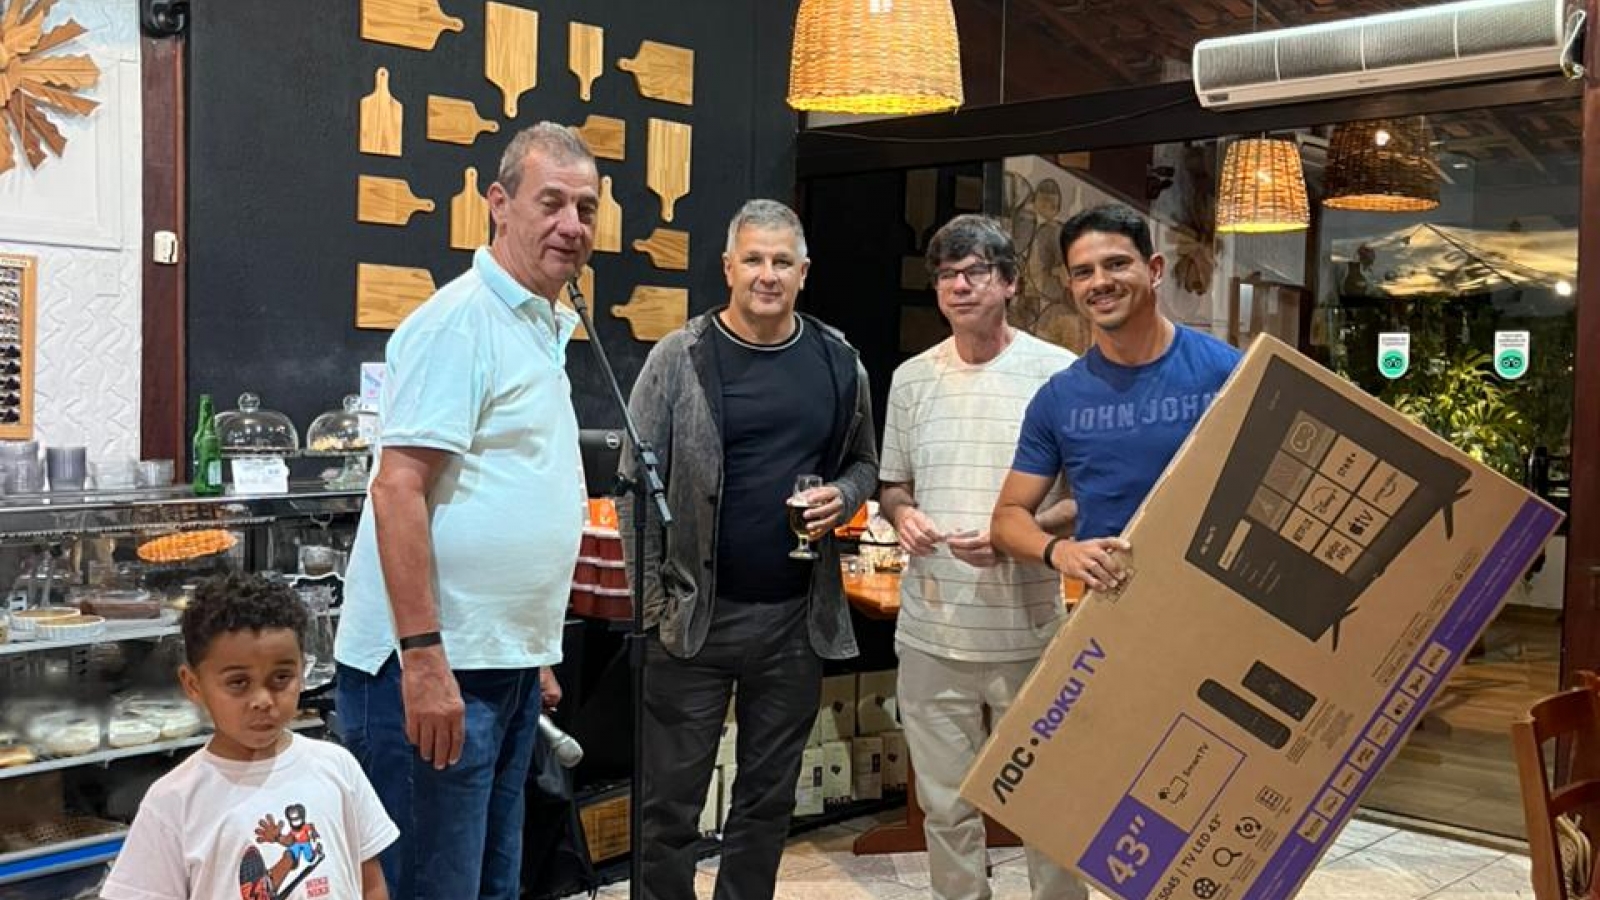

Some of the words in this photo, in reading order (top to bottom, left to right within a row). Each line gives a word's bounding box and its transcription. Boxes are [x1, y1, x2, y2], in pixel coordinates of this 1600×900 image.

[1062, 403, 1135, 433] JOHN
[992, 746, 1036, 805] AOC
[1072, 637, 1106, 675] TV
[1155, 876, 1180, 900] 5045
[1182, 851, 1196, 867] TV
[1193, 831, 1211, 855] LED
